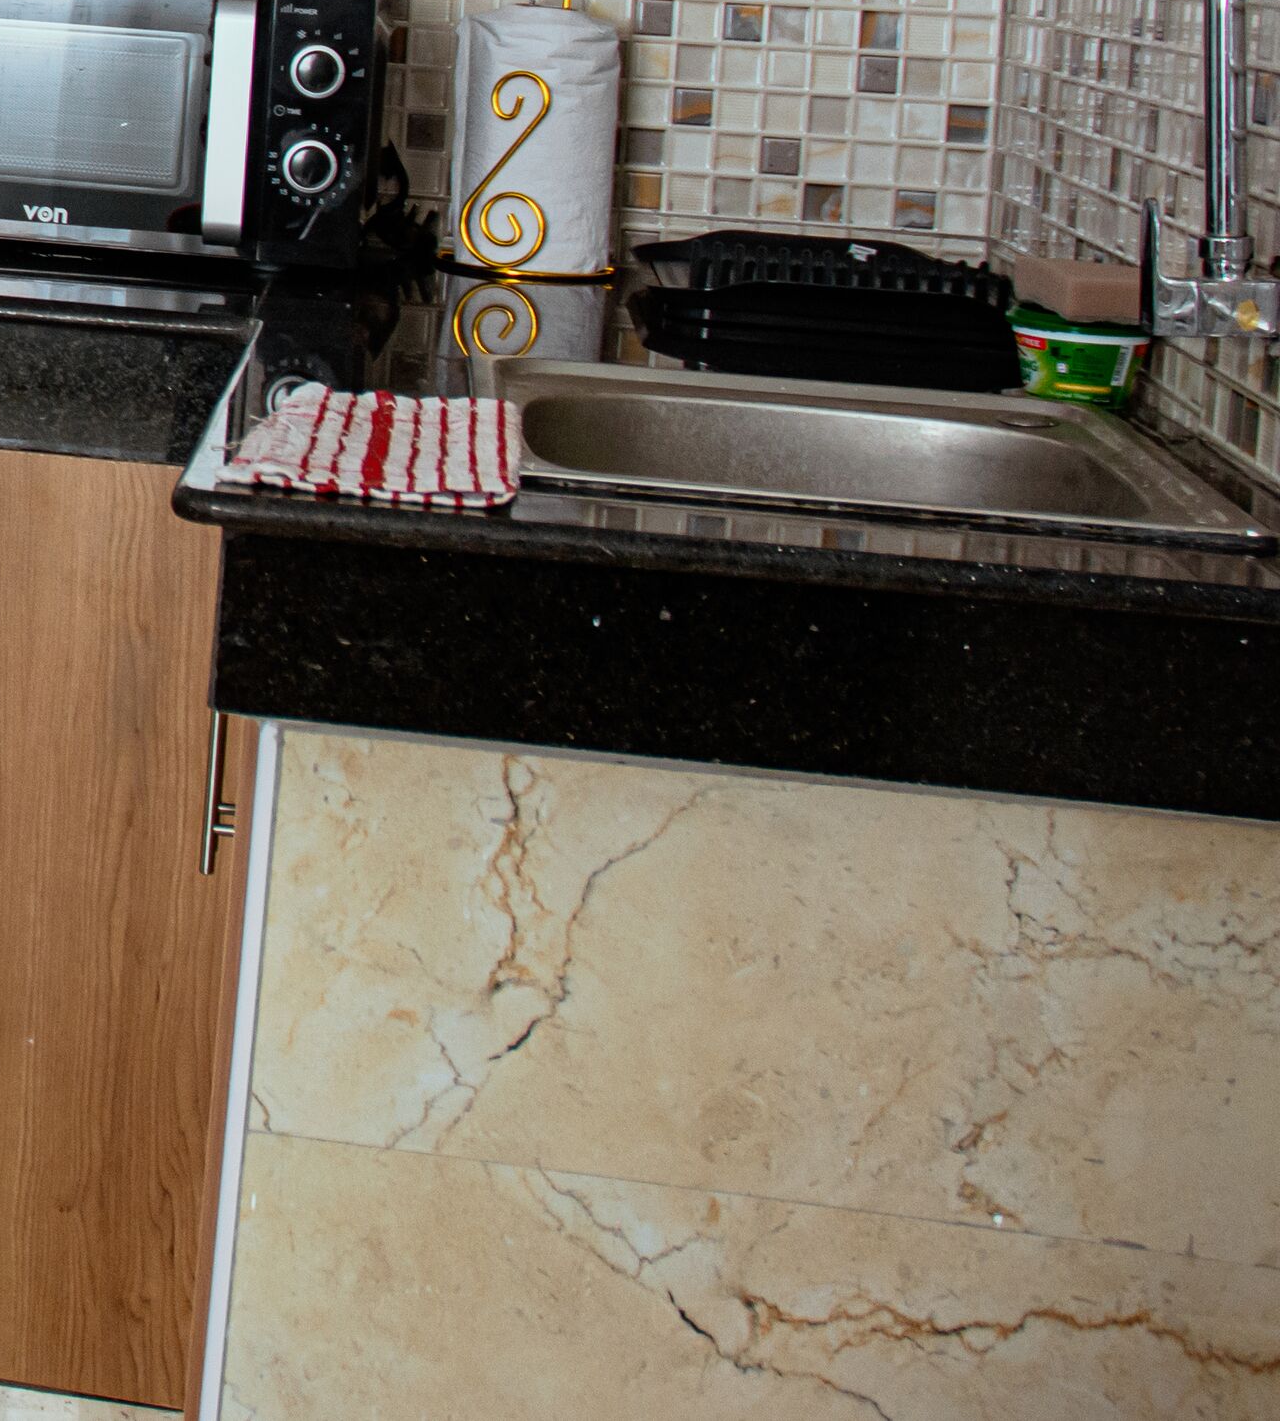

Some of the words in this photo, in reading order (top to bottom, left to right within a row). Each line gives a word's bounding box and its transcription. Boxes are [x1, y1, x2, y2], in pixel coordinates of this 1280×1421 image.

[294, 7, 319, 16] POWER
[287, 107, 302, 116] TIME
[23, 204, 69, 224] von
